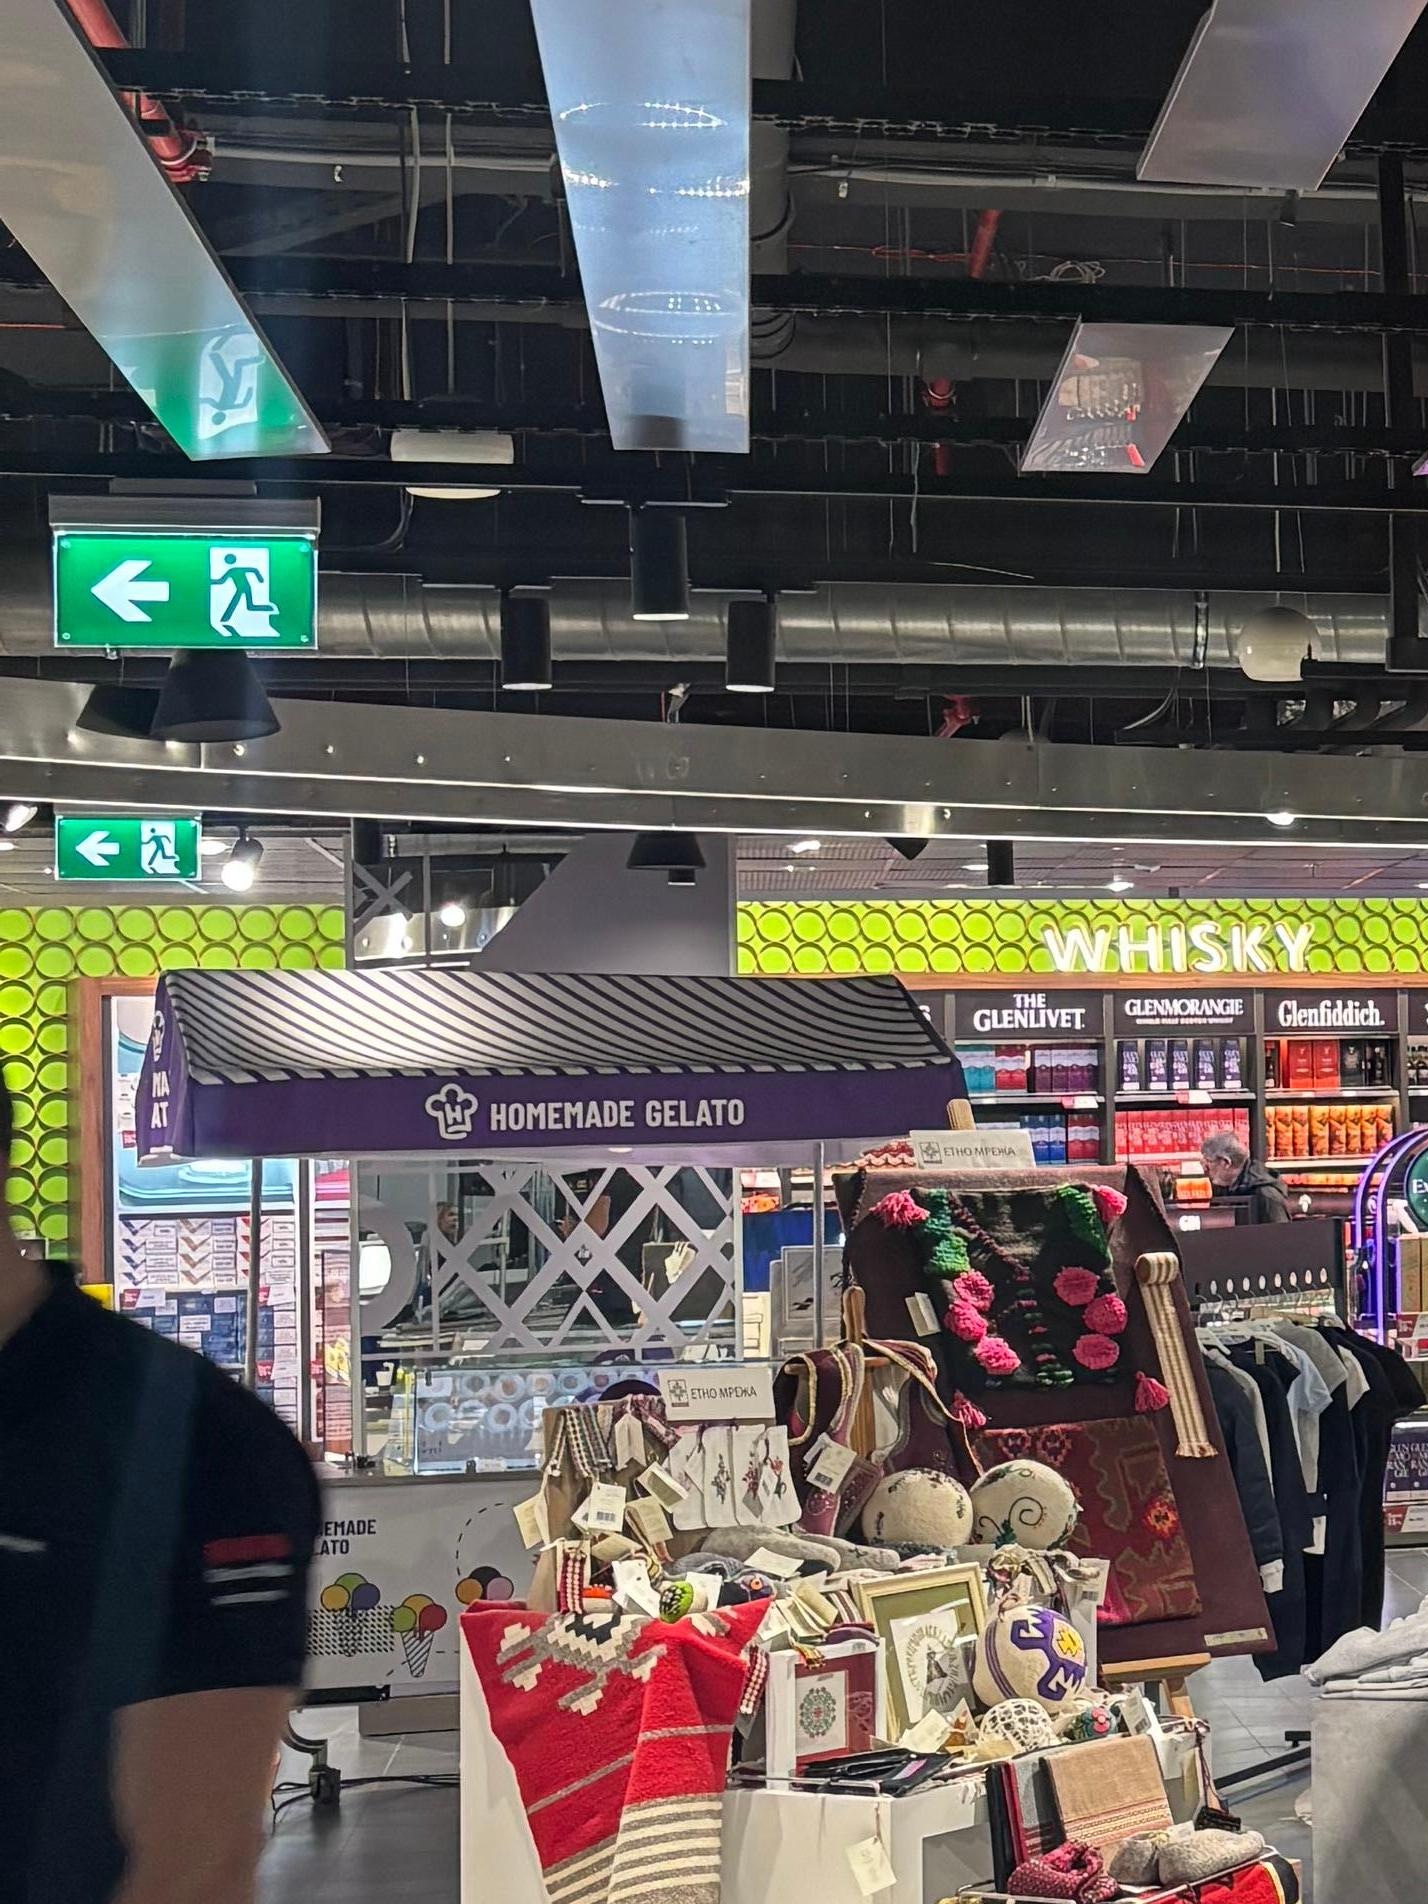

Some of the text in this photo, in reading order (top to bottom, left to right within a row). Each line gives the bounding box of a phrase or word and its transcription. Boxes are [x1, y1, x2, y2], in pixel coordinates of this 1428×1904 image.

[1041, 921, 1314, 973] WHISKY
[1013, 993, 1047, 1008] THE
[1125, 999, 1244, 1016] GLENMORANGIE
[490, 1100, 635, 1131] HOMEMADE
[645, 1099, 745, 1128] GELATO
[320, 1520, 376, 1536] EMADE
[317, 1539, 350, 1556] ATO
